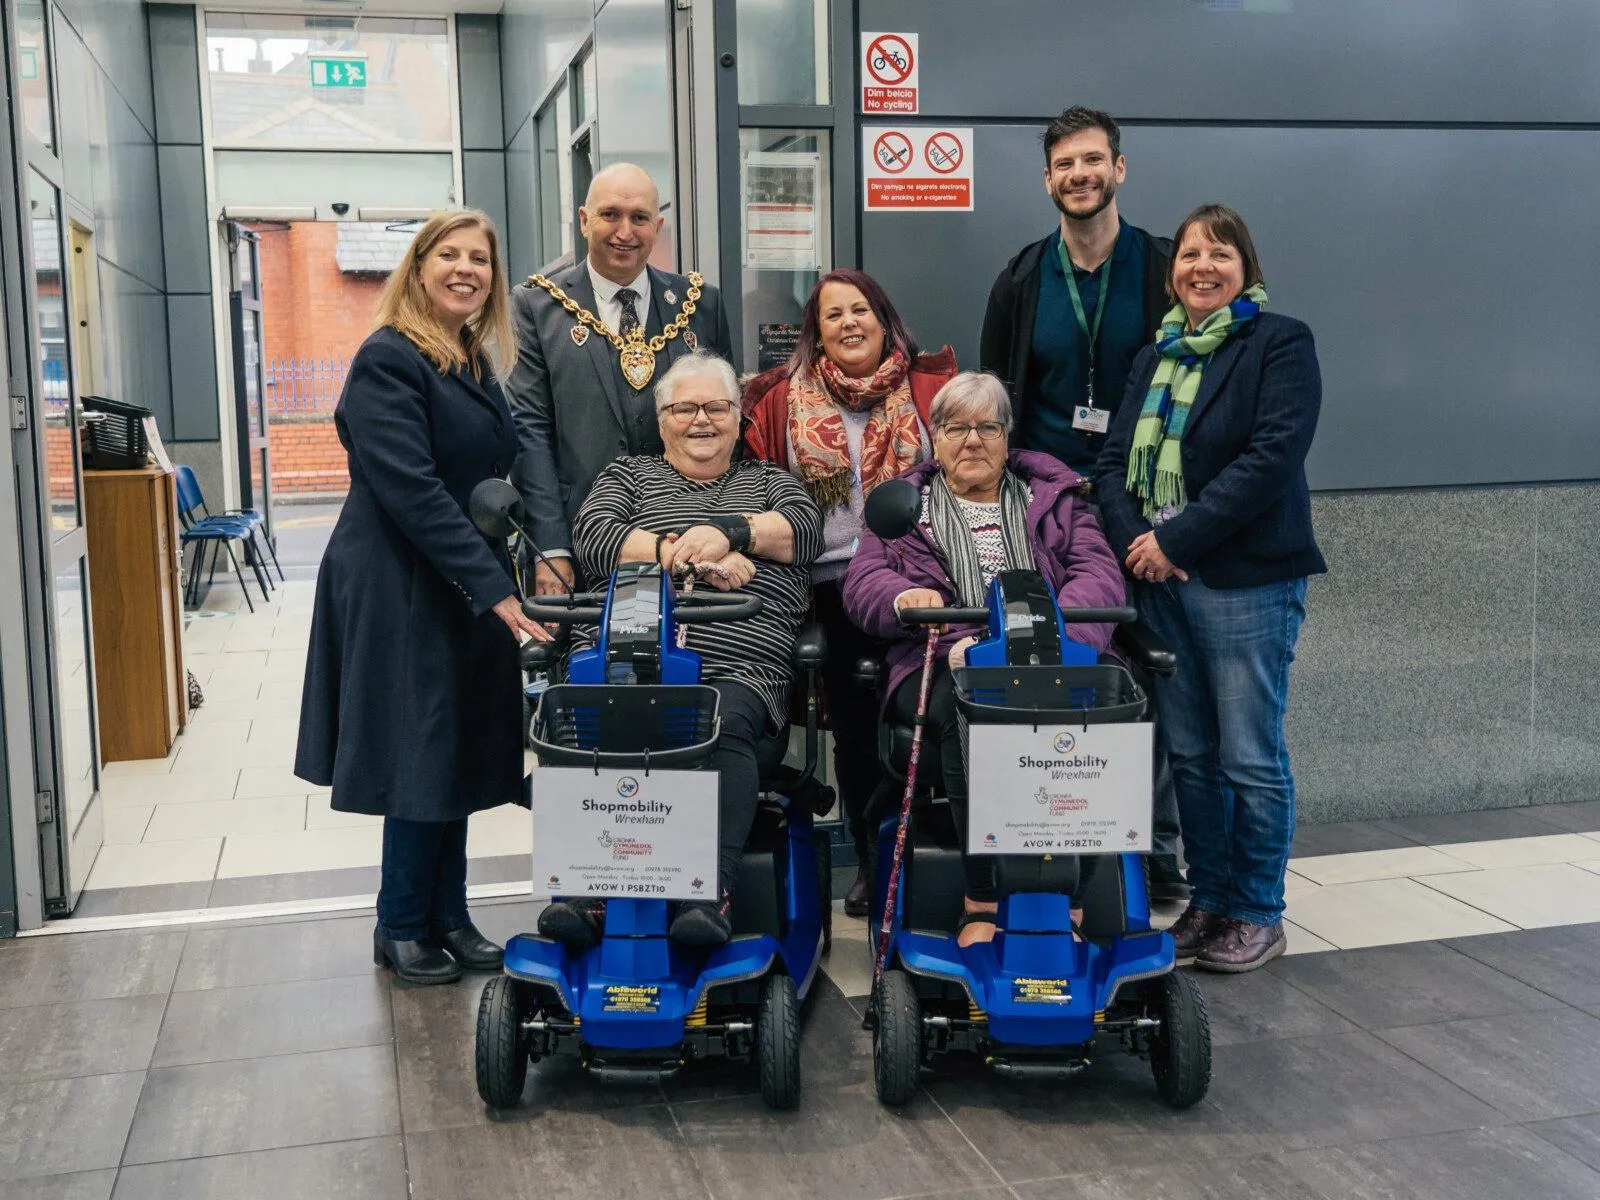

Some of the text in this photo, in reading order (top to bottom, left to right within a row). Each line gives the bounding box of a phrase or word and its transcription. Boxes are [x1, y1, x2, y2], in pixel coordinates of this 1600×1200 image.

[867, 89, 913, 98] Dim beicio
[868, 100, 913, 110] No cycling
[915, 183, 938, 191] sigarets
[939, 183, 967, 191] electronig
[891, 194, 915, 202] smoking
[1018, 614, 1047, 622] Pride
[620, 625, 650, 634] Pride
[1019, 755, 1108, 770] Shopmobility
[1051, 770, 1101, 780] Wrexham
[582, 799, 673, 815] Shopmobility
[615, 814, 665, 825] Wrexham
[1064, 839, 1102, 847] PSBZT10
[588, 883, 618, 891] AVOW
[627, 884, 666, 893] PSBZT10
[607, 986, 657, 994] Ableworld
